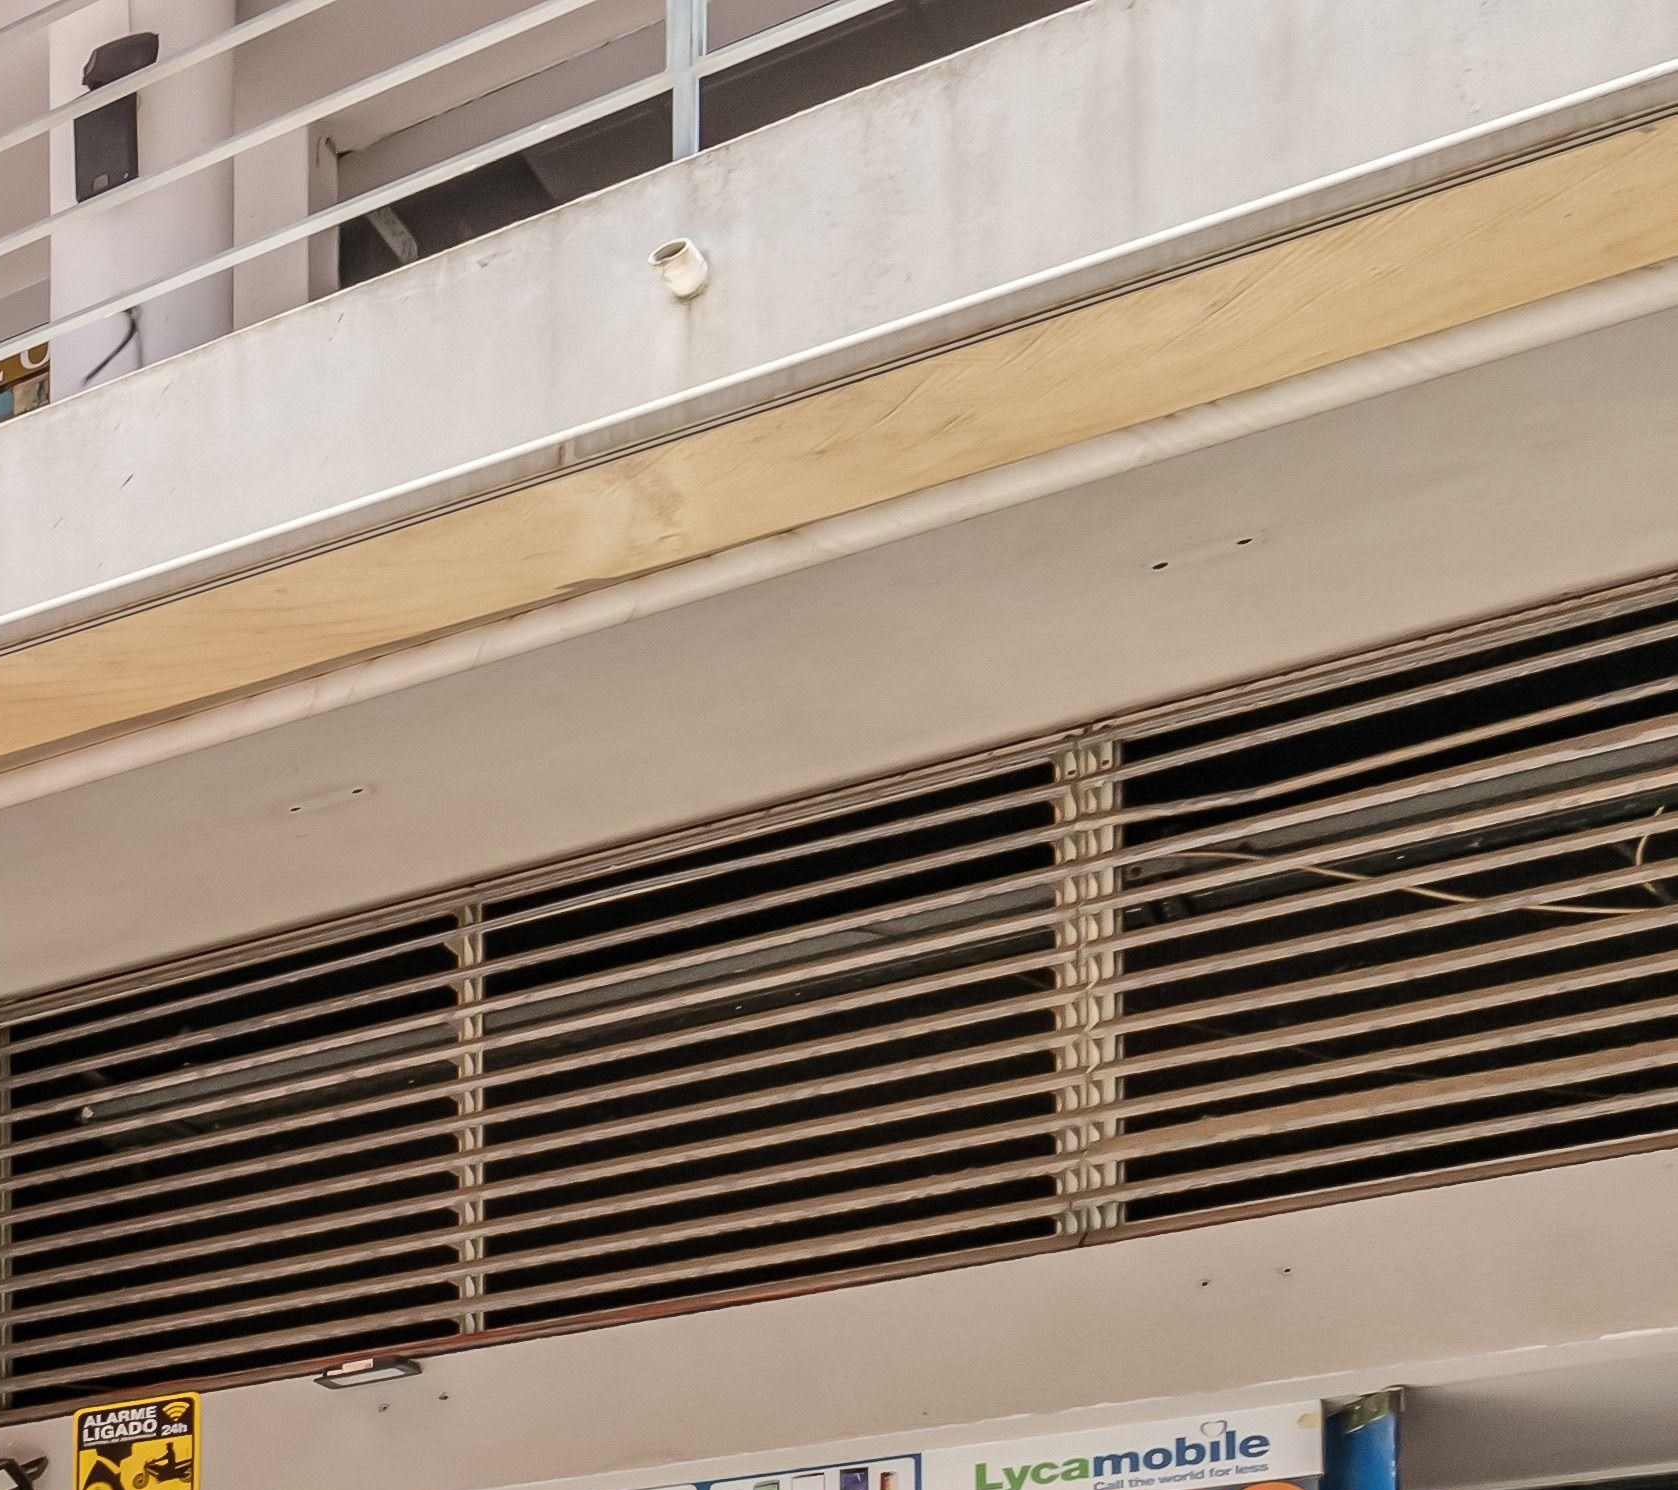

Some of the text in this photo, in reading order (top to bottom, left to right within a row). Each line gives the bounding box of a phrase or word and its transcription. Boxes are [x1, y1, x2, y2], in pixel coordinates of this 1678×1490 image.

[83, 1406, 158, 1428] ALARME
[83, 1418, 188, 1442] LIGADO 24h
[1128, 1476, 1155, 1489] the
[1157, 1468, 1205, 1485] world
[1209, 1465, 1232, 1479] for
[1234, 1462, 1269, 1476] less
